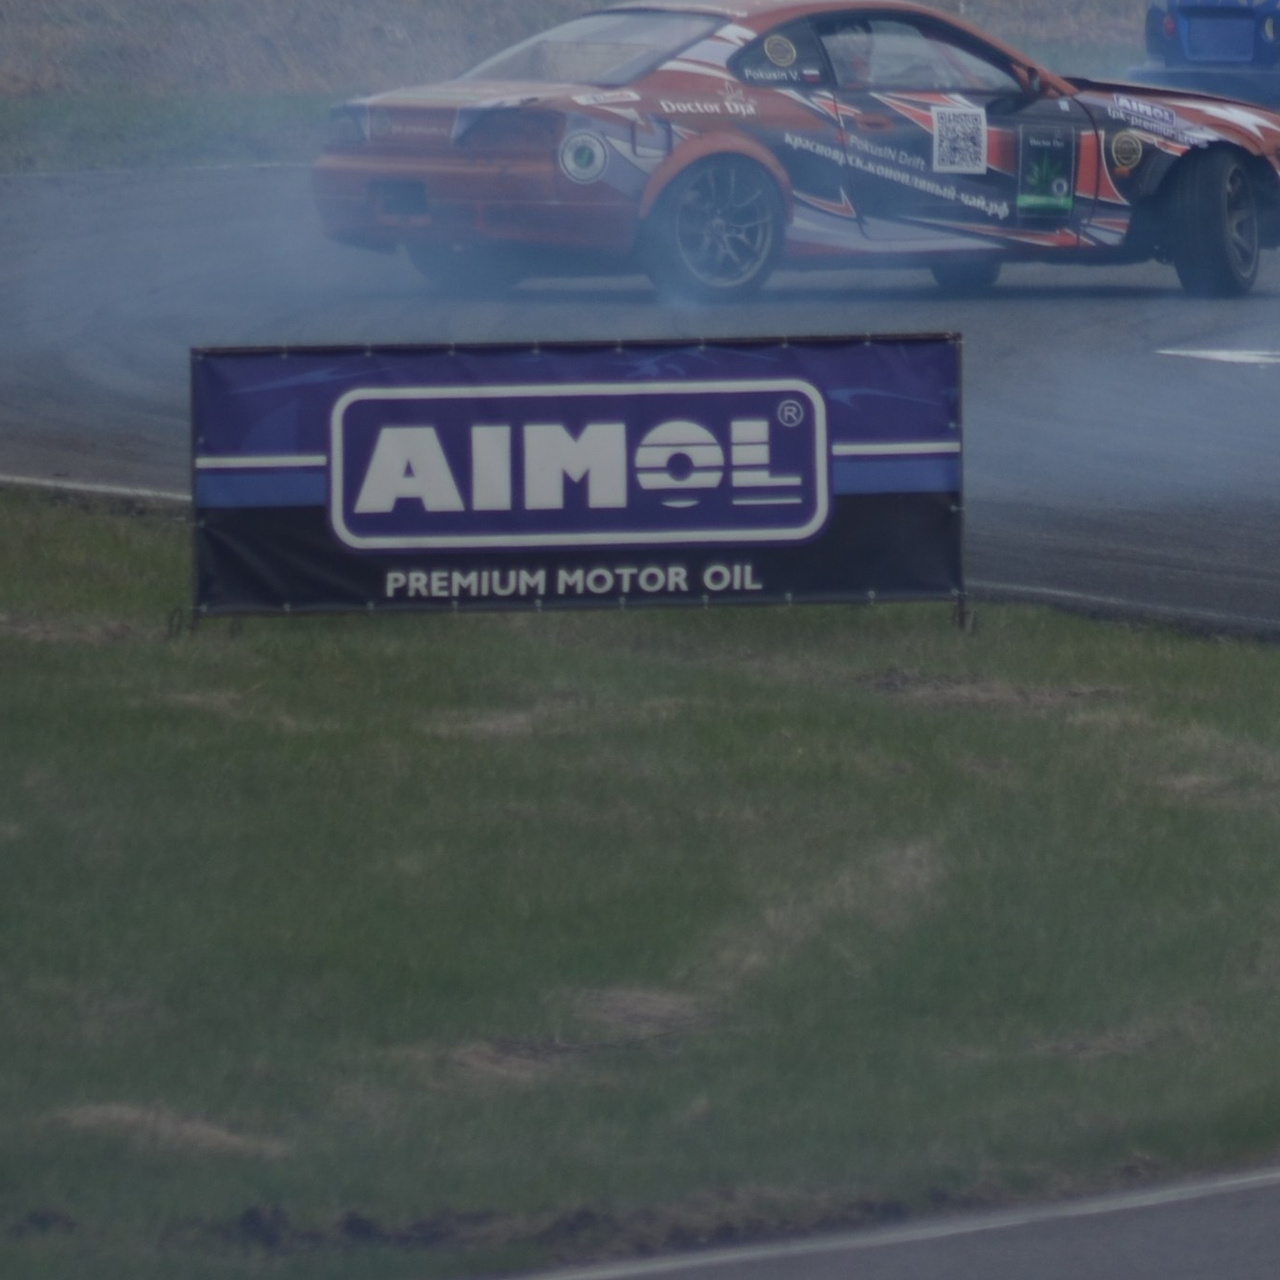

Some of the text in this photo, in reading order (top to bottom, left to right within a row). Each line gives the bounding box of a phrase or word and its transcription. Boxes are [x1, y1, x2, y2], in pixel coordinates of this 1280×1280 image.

[660, 99, 721, 115] Doctor
[353, 418, 803, 515] AIMOL
[385, 563, 763, 599] PREMIUM MOTOR OIL
